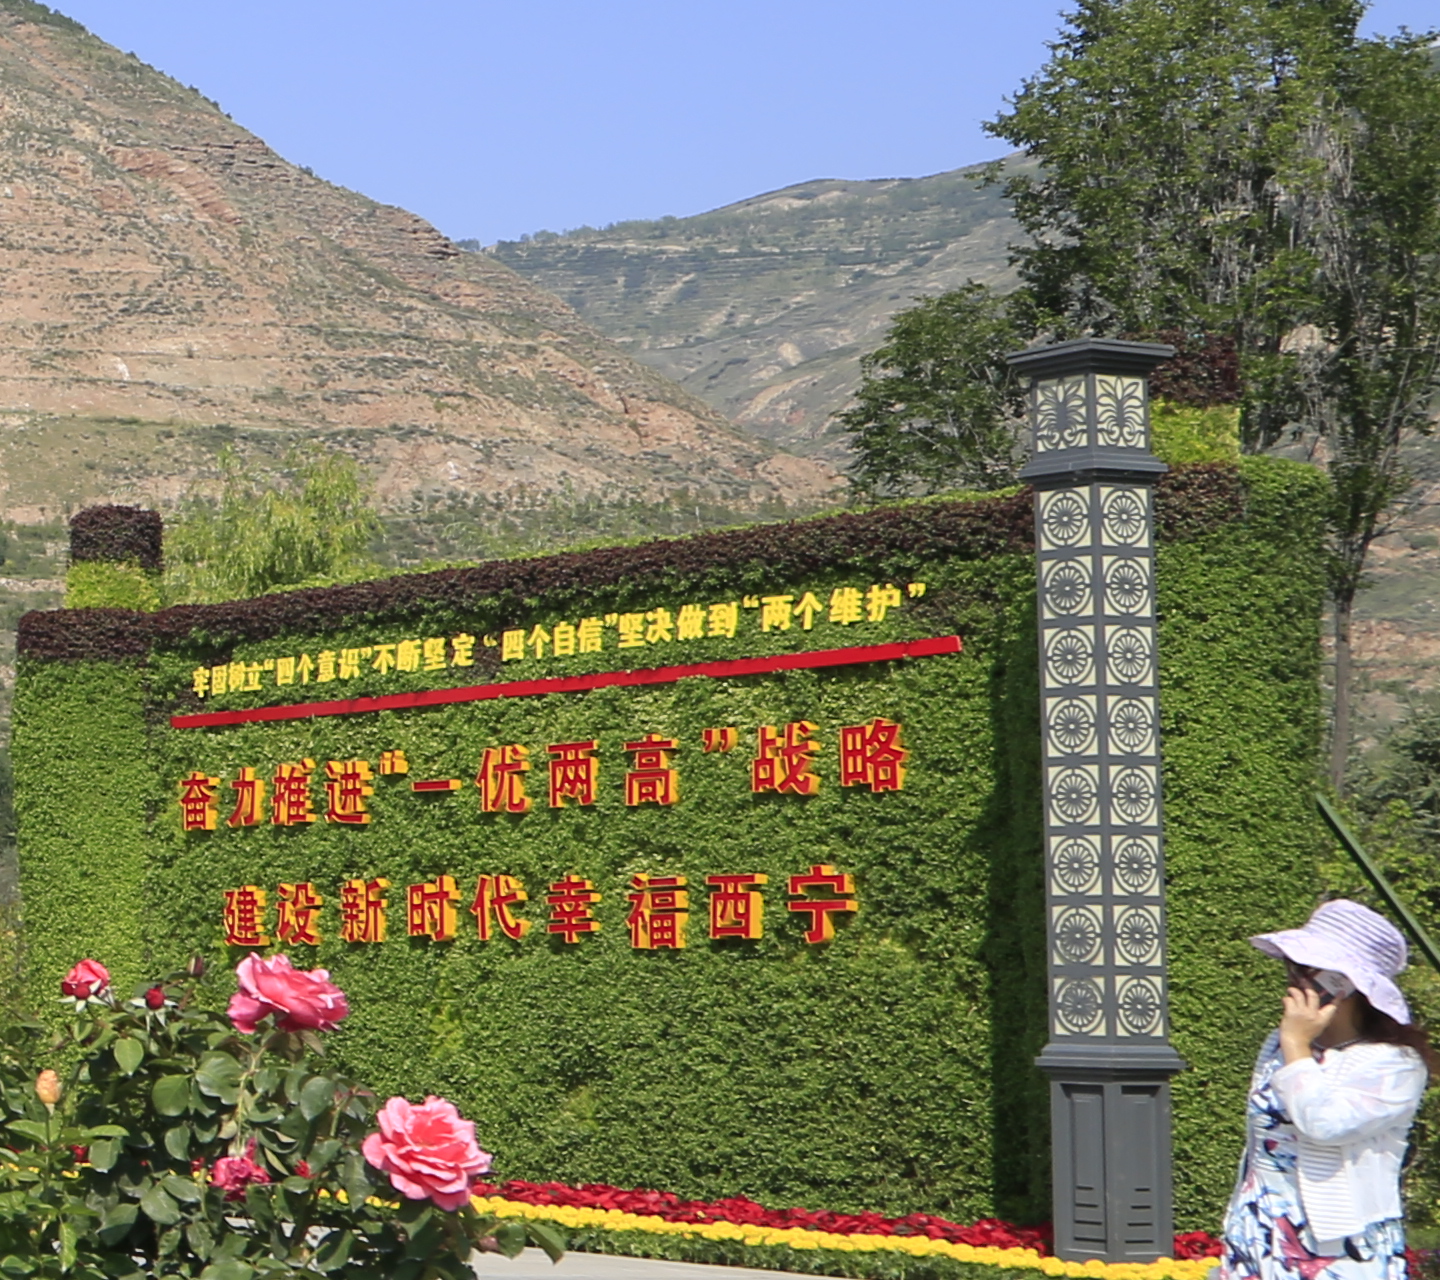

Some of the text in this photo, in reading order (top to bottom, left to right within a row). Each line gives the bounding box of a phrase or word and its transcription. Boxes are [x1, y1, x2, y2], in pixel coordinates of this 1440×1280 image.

[180, 718, 909, 831] 奋力推进“一优两高”战略
[223, 863, 859, 950] 建设新时代幸福西宁
